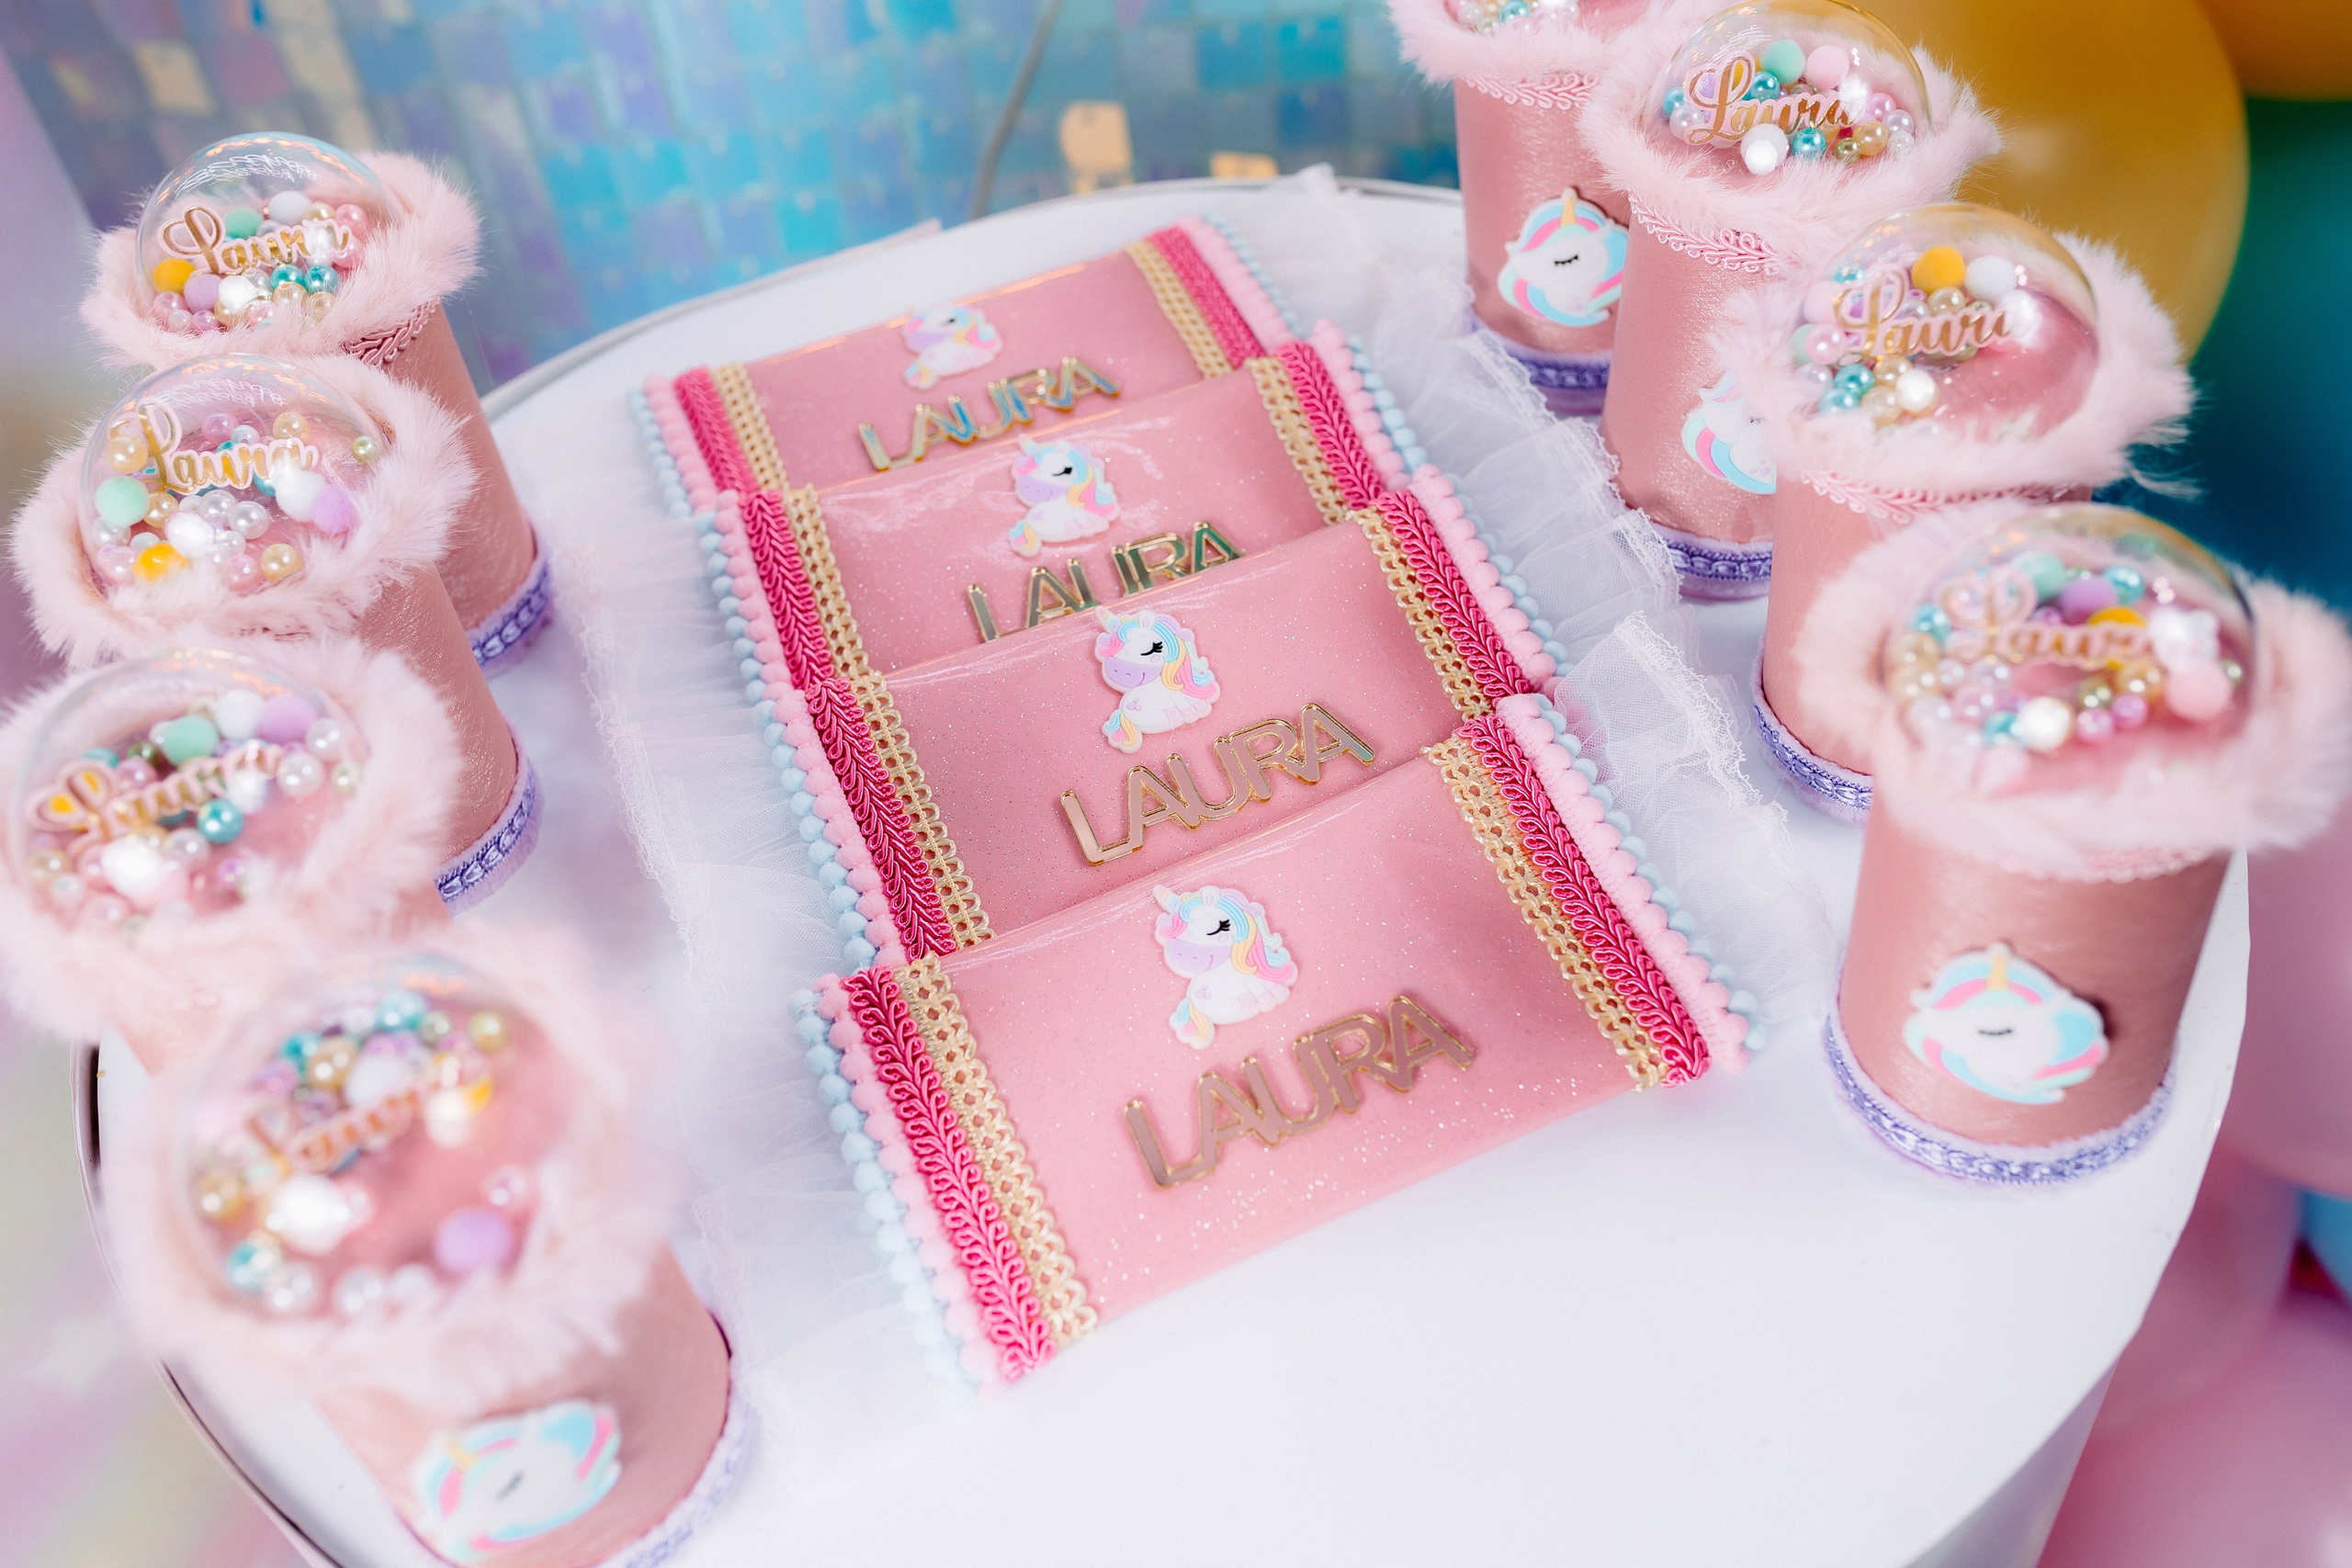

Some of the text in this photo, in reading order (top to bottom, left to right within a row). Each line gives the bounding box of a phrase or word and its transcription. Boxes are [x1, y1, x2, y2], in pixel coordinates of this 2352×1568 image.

[1683, 50, 1867, 145] Laura
[157, 202, 352, 277] Laura
[106, 396, 320, 496] Laura
[859, 355, 1121, 471] LAURA
[967, 520, 1245, 642] LAURA
[1937, 562, 2159, 671] Laur
[1059, 702, 1375, 865] LAURA
[1124, 994, 1473, 1189] LAURA
